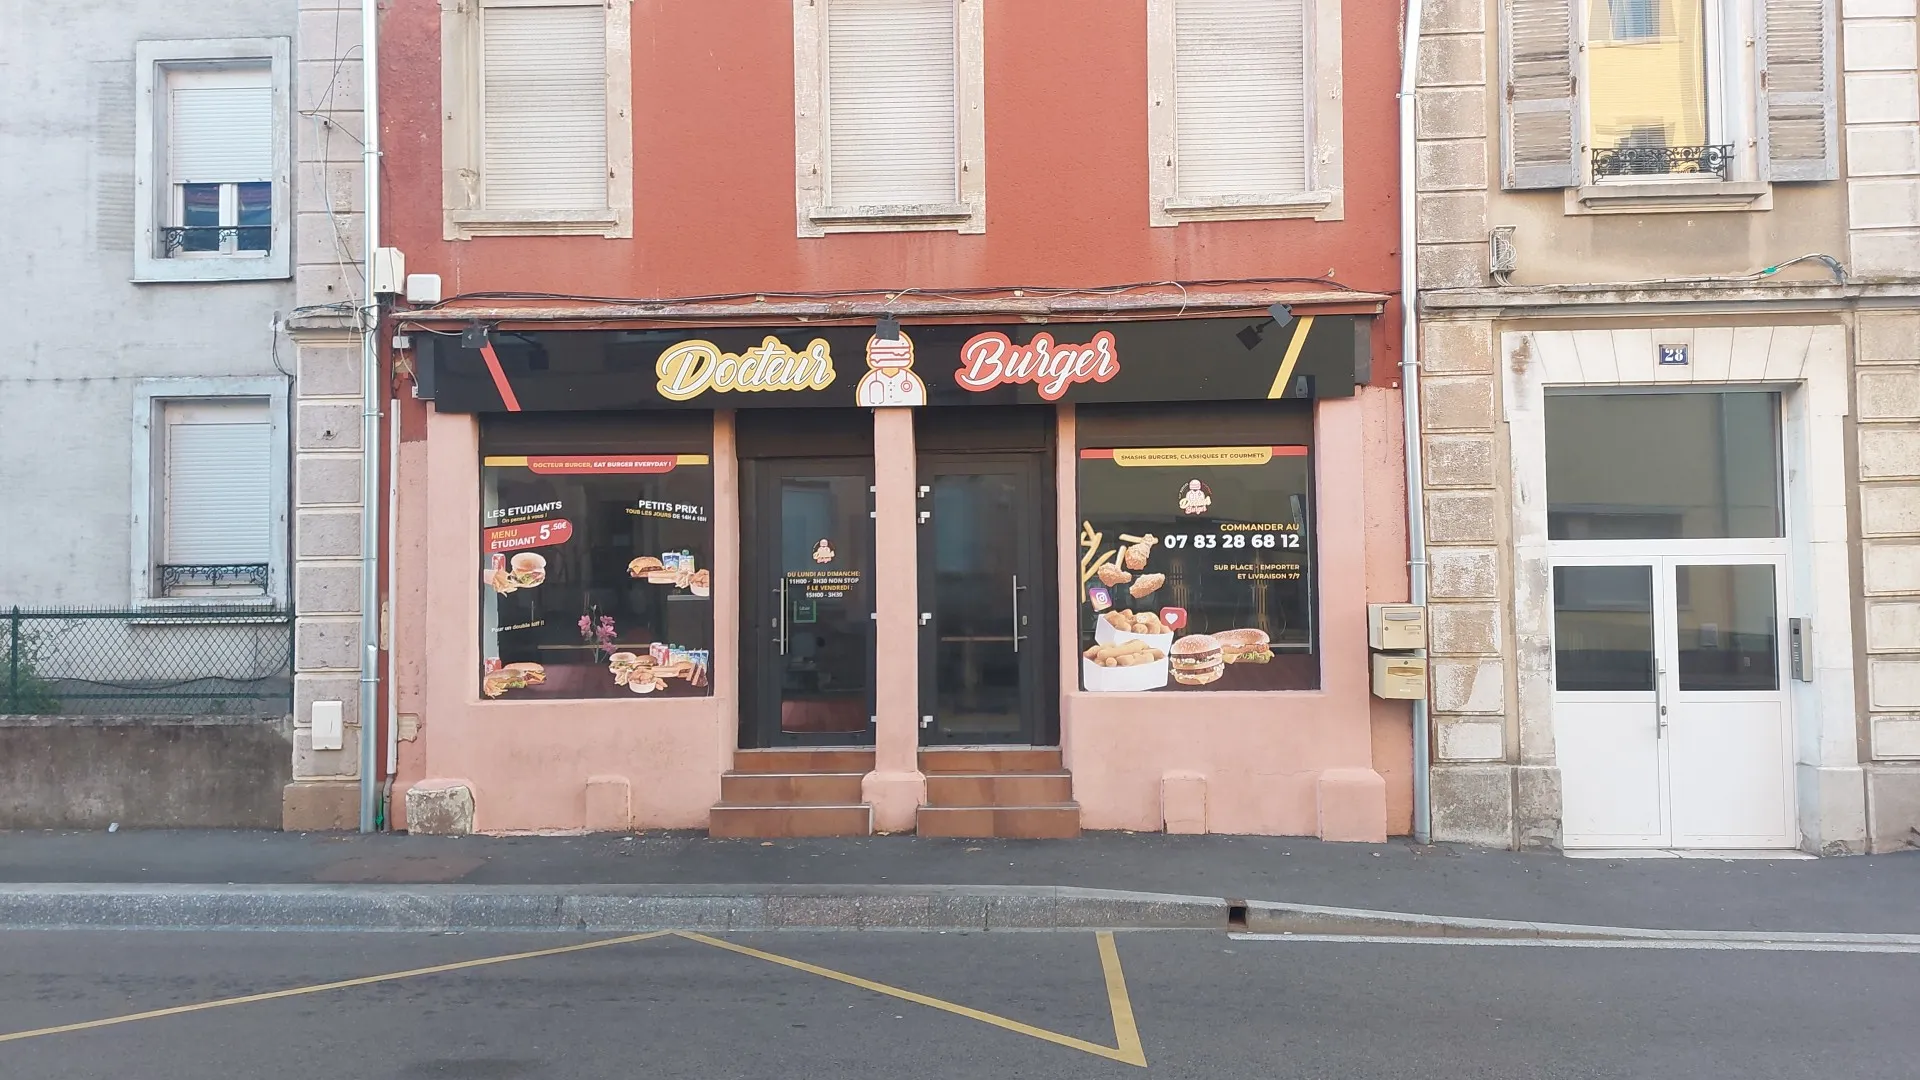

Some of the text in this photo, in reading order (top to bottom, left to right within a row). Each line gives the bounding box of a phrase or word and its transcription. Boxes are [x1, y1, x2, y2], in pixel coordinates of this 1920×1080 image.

[1665, 348, 1683, 361] 28
[659, 339, 833, 397] Docteur
[958, 334, 1117, 397] Burger
[487, 501, 562, 519] LES ETUDIANTS
[639, 500, 672, 511] PETITS
[675, 504, 698, 514] PRIX
[491, 529, 518, 539] MENU
[540, 524, 550, 540] 5
[491, 536, 536, 549] ÉTUDIANT
[1164, 534, 1300, 549] 07 83 28 68 12
